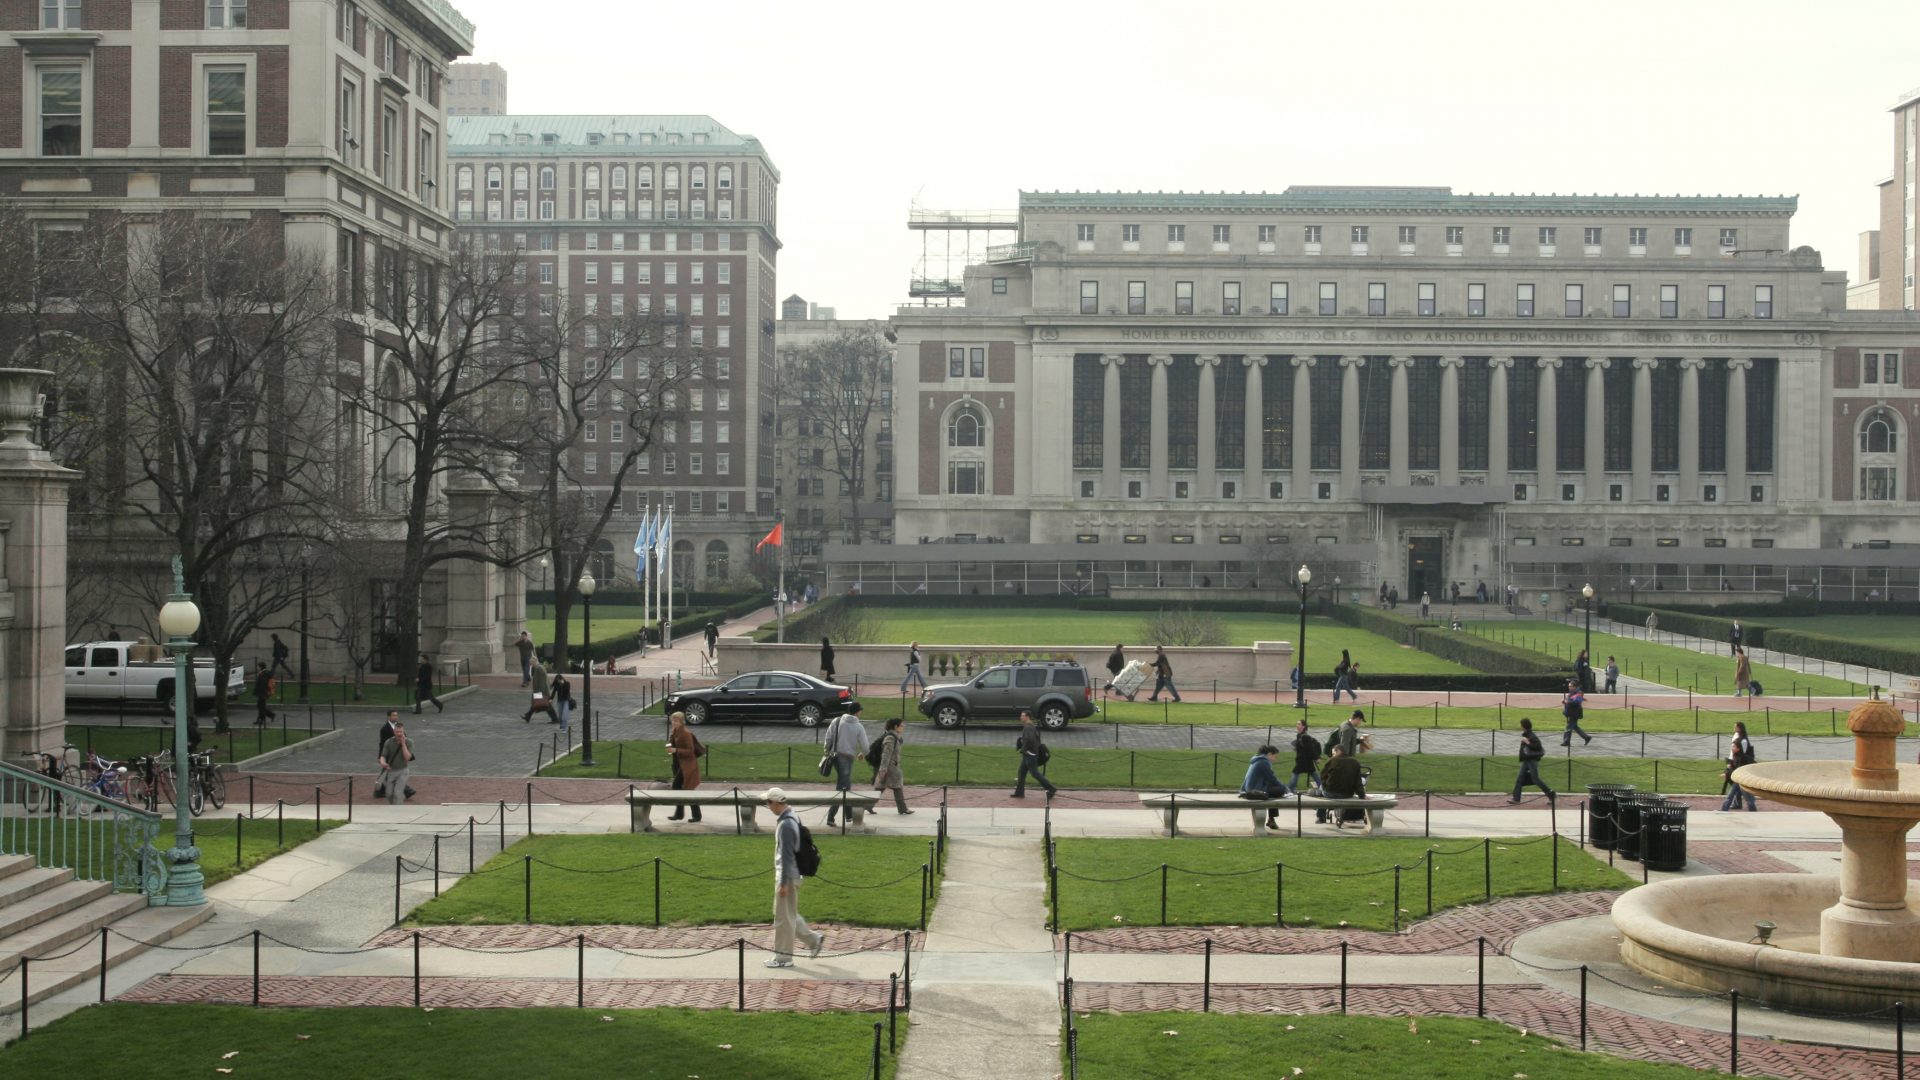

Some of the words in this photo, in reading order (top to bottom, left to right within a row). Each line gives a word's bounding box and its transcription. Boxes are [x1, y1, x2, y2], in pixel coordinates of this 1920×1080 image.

[1121, 329, 1170, 341] HOMER
[1179, 329, 1265, 342] HERODOTUS
[1275, 330, 1357, 343] SOPHOCLES
[1424, 331, 1500, 343] ARISTOTLE
[1509, 331, 1611, 344] DEMOSTHENES
